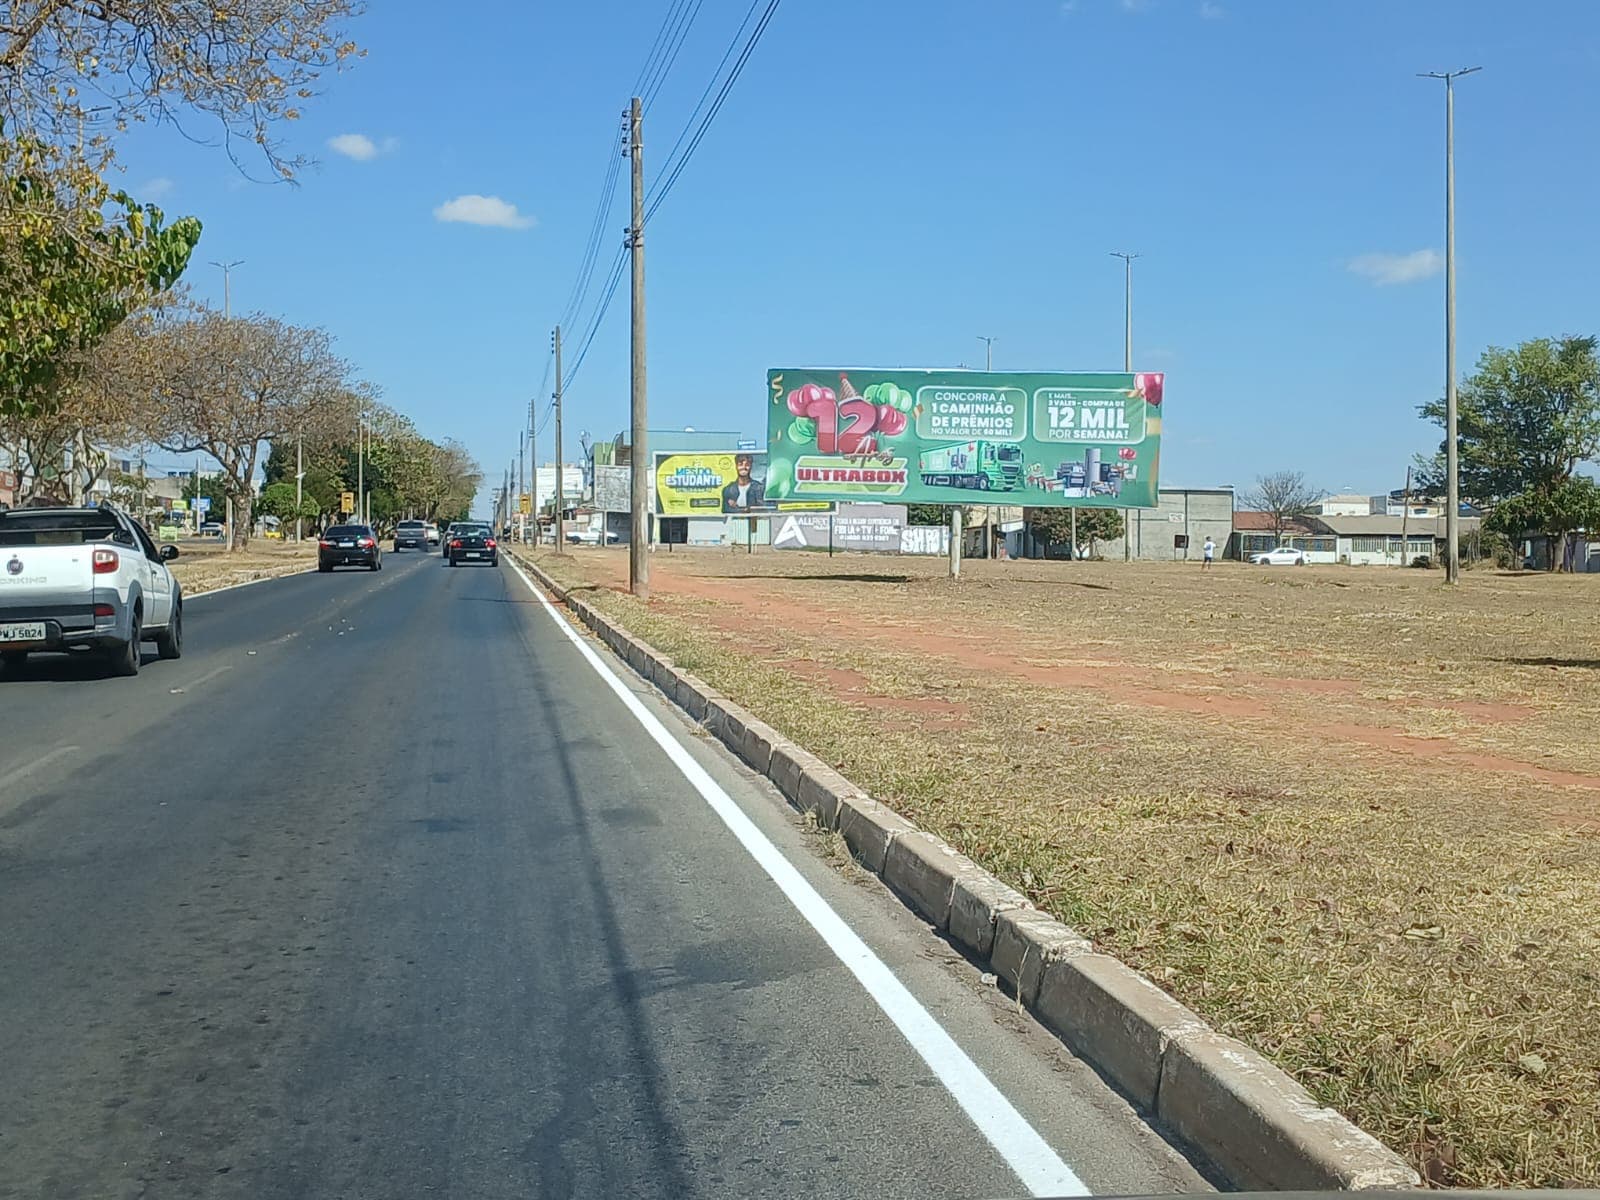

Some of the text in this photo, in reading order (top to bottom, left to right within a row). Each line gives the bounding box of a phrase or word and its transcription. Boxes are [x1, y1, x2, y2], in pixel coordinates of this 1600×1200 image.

[934, 391, 1007, 402] CONCORRA A
[931, 402, 1015, 415] 1 CAMINHÃO
[931, 414, 1014, 429] DE PRÊMIOS
[1048, 406, 1130, 429] 12 MIL
[807, 396, 878, 454] 12
[945, 428, 970, 436] VALOR
[1049, 429, 1130, 440] POR SEMANA!
[666, 474, 723, 487] ESTUDANTE
[797, 468, 906, 483] ULTRABOX
